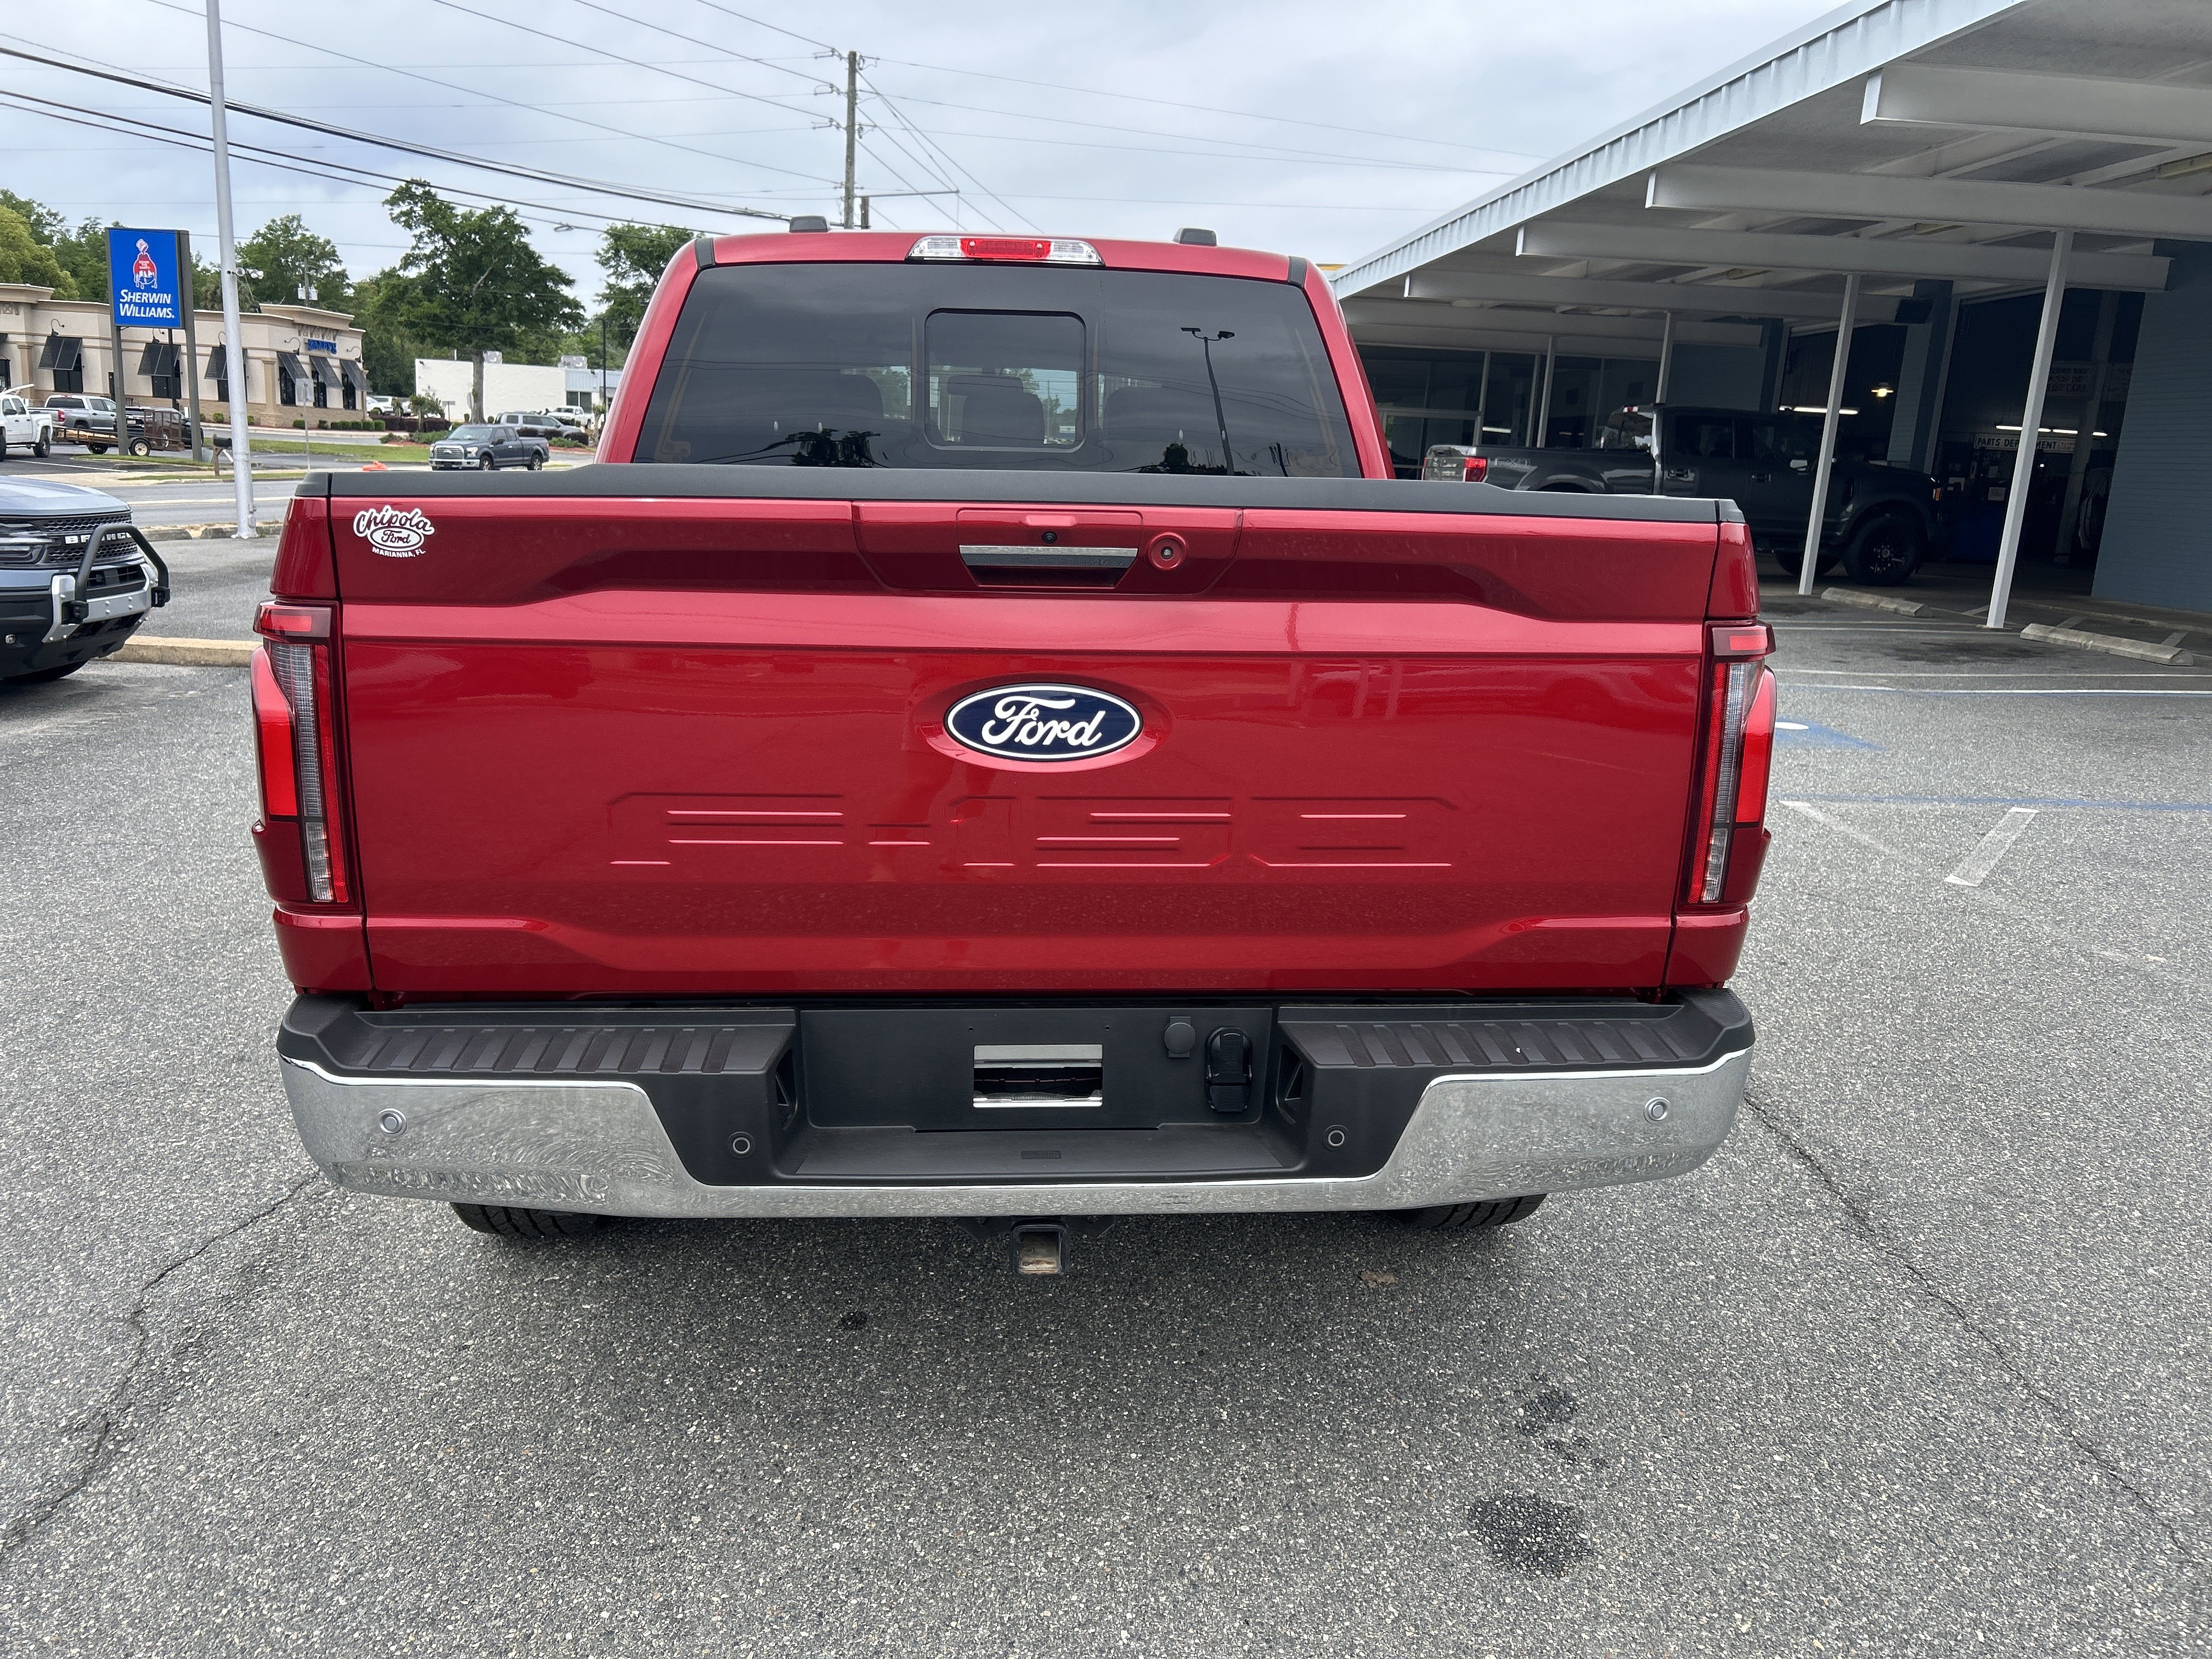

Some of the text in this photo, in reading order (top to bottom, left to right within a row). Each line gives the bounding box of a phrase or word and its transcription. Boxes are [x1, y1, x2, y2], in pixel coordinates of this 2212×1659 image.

[120, 289, 171, 304] SHERWIN
[1977, 438, 2001, 446] PARTS
[2004, 439, 2057, 449] DEPMENT
[354, 506, 433, 535] Chipola
[65, 532, 132, 544] BRNC
[381, 529, 411, 544] Ford
[372, 546, 416, 558] MARIANNA,
[981, 695, 1106, 747] Ford
